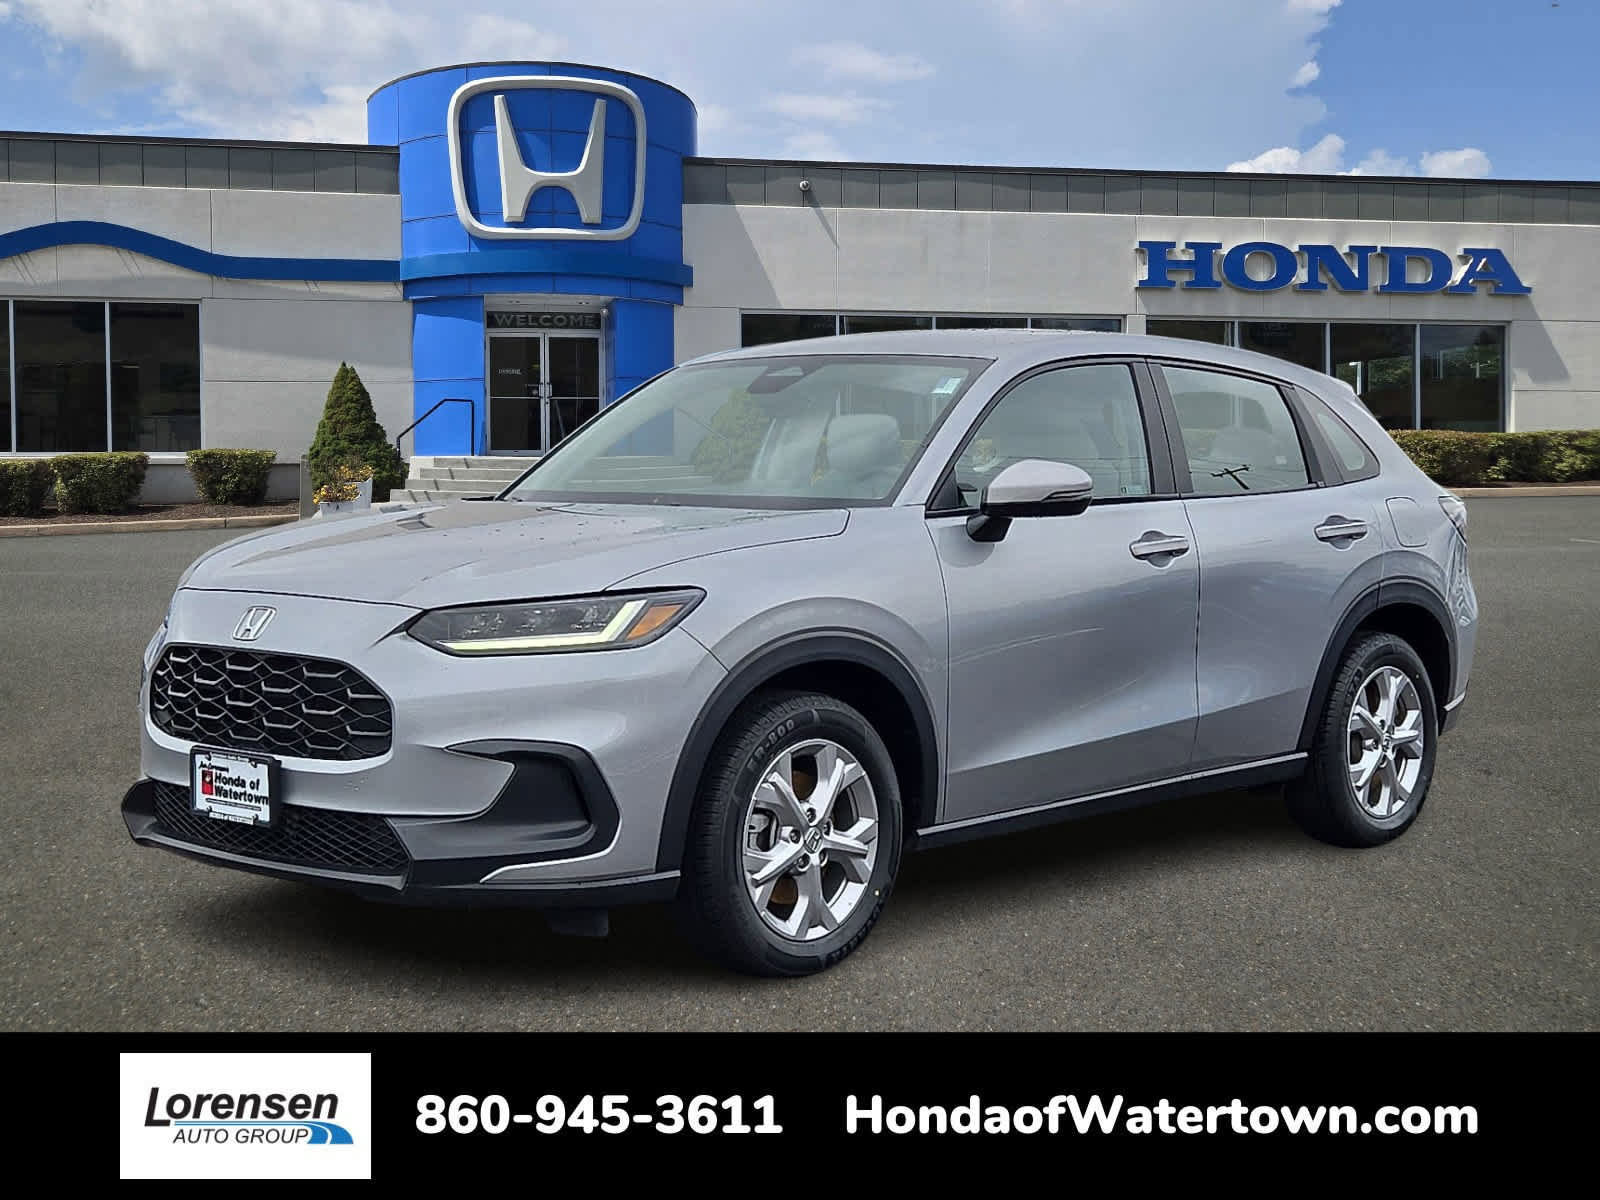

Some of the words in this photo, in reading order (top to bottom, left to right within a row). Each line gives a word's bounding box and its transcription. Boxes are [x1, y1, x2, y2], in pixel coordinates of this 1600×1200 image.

[1135, 240, 1533, 296] HONDA
[494, 313, 596, 327] WELCOME
[214, 772, 246, 789] Honda
[249, 778, 261, 791] of
[214, 785, 269, 806] Watertown
